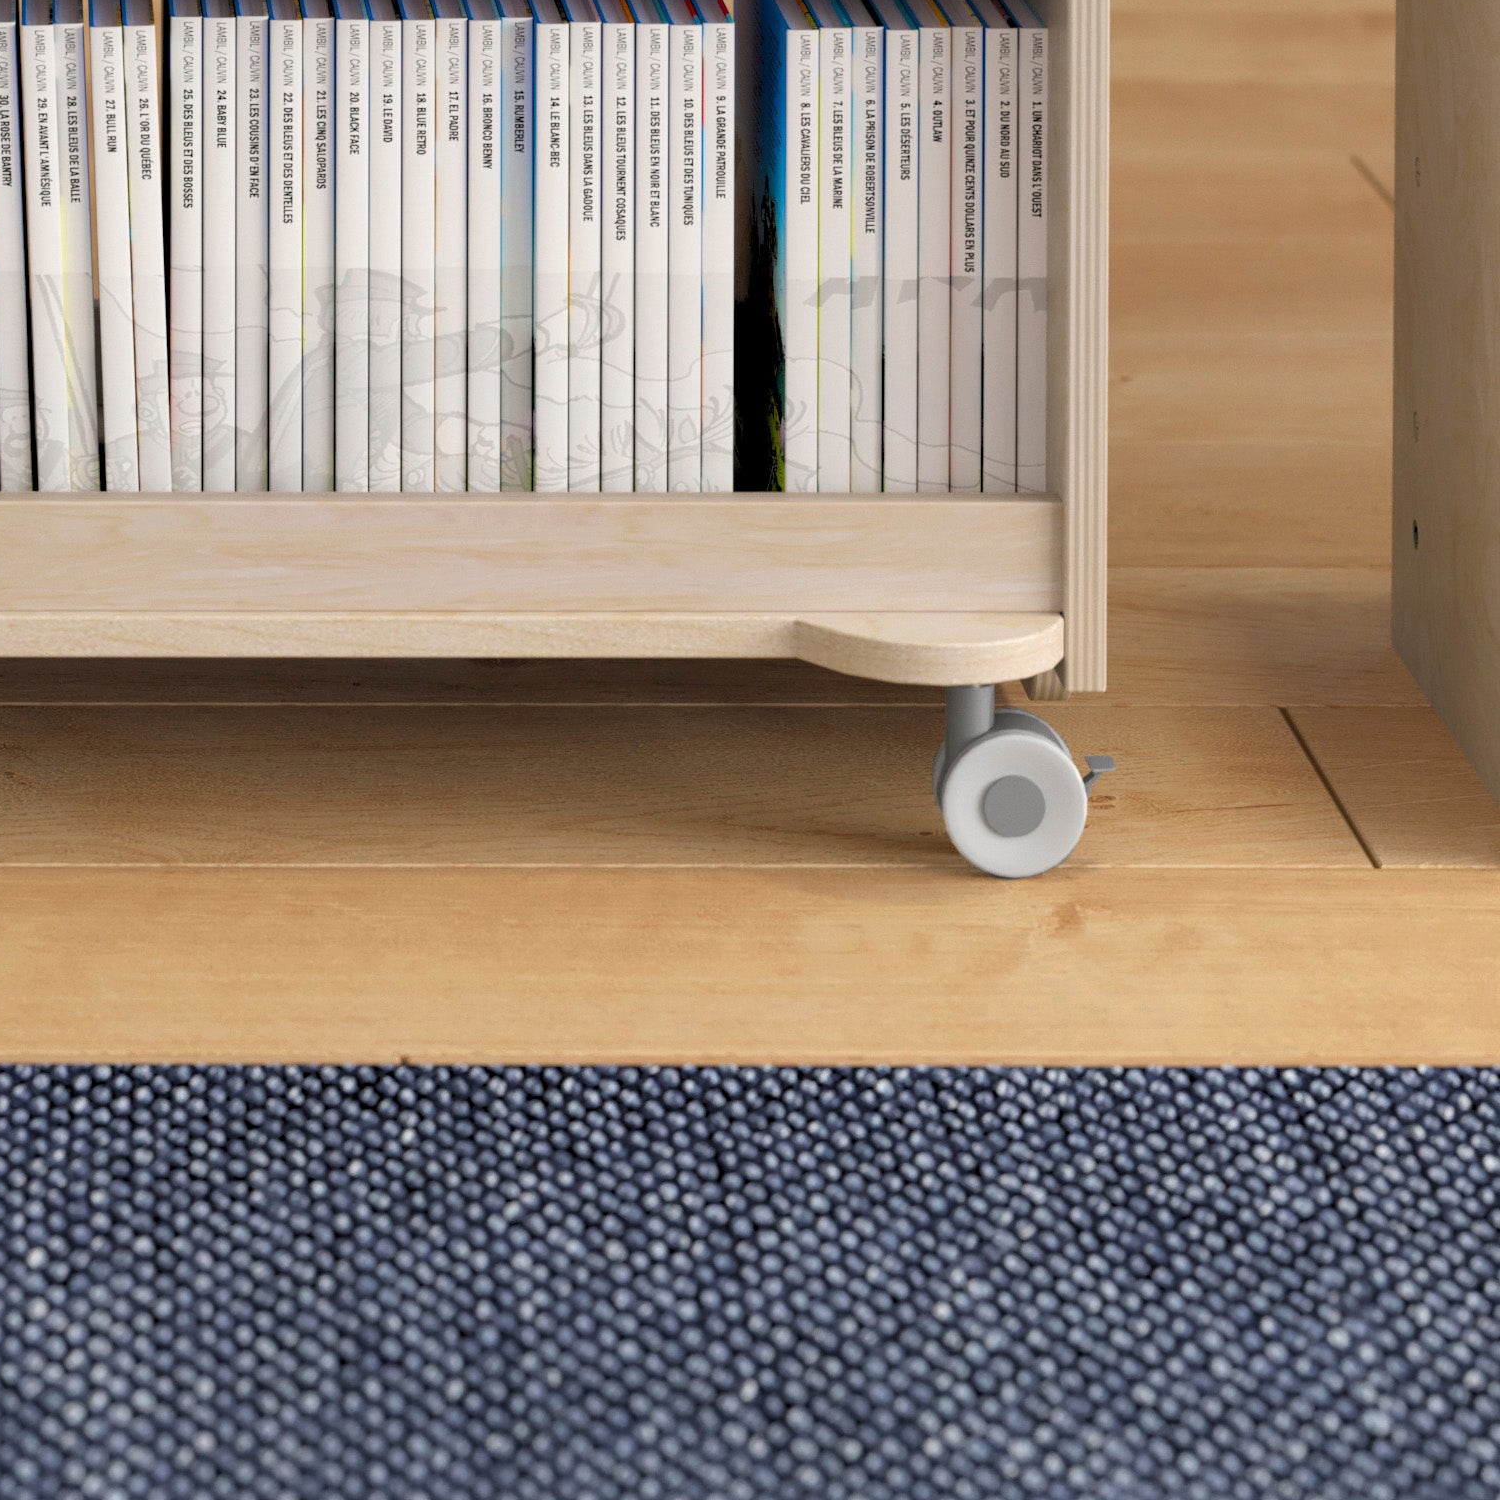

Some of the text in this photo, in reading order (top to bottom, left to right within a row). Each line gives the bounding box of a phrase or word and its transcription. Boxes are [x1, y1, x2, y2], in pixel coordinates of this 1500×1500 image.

[38, 98, 47, 111] 29.
[139, 98, 149, 112] 26.
[250, 88, 259, 102] 23.
[250, 103, 259, 118] LES
[449, 91, 458, 142] 17. EL PADRE
[833, 109, 843, 124] LES
[1033, 101, 1042, 109] 1.
[1033, 110, 1042, 123] UN
[0, 94, 11, 187] 30. LA ROSE DE BANTRY
[38, 113, 47, 124] EN
[39, 125, 49, 150] AVANT
[106, 99, 116, 153] 27. BULL RUN
[141, 134, 150, 146] DU
[217, 90, 226, 148] 24. BABY BLUE
[249, 119, 259, 155] COUSINS
[315, 90, 326, 190] 21. LES CINQ SALOPARDS
[350, 92, 359, 155] 20. BLACK FACE
[383, 94, 392, 143] 19. LE DAVID
[417, 93, 426, 155] 18. BLUE RETRO
[483, 93, 492, 170] 16. BRONCO BENNY
[515, 90, 524, 153] 15. RUMBERLEY
[550, 97, 560, 168] 14. LE BLANC-BEC
[833, 126, 843, 152] BLEUS
[901, 102, 911, 180] 5. LES DÉSERTEURS
[933, 100, 942, 143] 4. OUTLAW
[1000, 101, 1010, 178] 2. DU NORD AU SUD
[1032, 124, 1042, 159] CHARIOT
[67, 96, 80, 203] 28. LES BLEUS DE LA BALLE
[139, 147, 151, 180] QUÉBEC
[615, 96, 626, 241] 12. LES BLEUS TOURNENT COSAQUES
[650, 97, 660, 227] 11. DES BLEUS EN NOIR ET BLANC
[716, 96, 726, 199] 9. LA GRANDE PATROUILLE
[801, 102, 810, 204] 8. LES CAVALIERS DU CIEL
[833, 153, 843, 165] DE
[865, 99, 875, 233] 6. LA PRISON DE ROBERTSONVILLE
[250, 178, 259, 198] FACE
[833, 166, 842, 176] LA
[833, 177, 842, 209] MARINE
[964, 99, 975, 273] 3. ET POUR QUINZE CENTS DOLLARS EN PLUS
[1032, 160, 1042, 182] DANS
